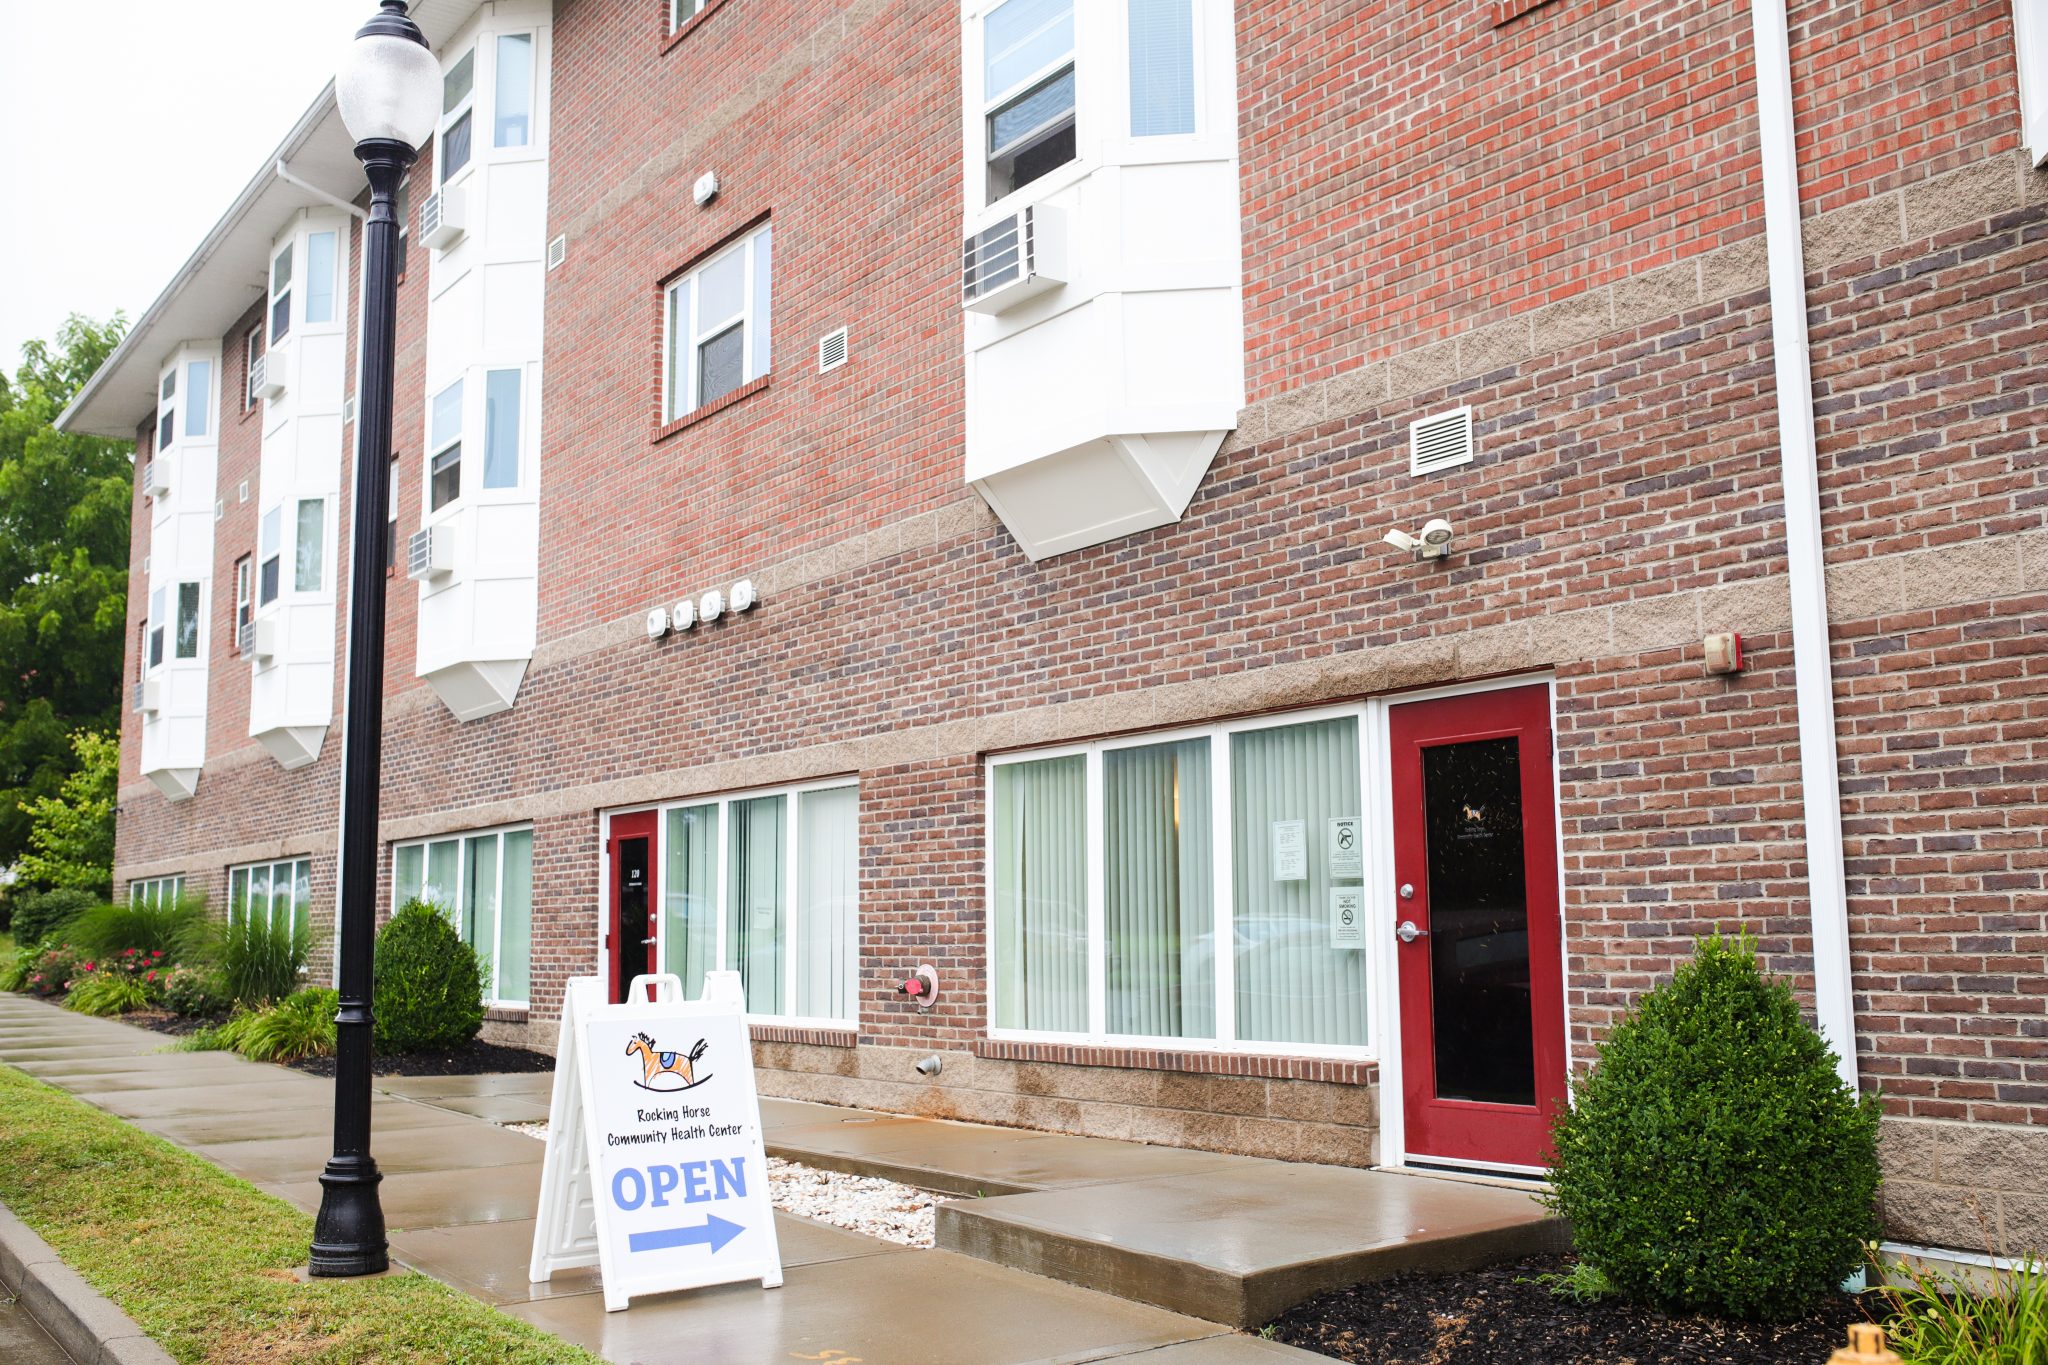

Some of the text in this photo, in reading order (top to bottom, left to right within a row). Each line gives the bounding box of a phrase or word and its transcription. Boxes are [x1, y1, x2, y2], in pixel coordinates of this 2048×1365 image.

[637, 1105, 710, 1122] Rocking Horse
[607, 1124, 742, 1146] Community Health Center
[611, 1156, 747, 1211] OPEN
